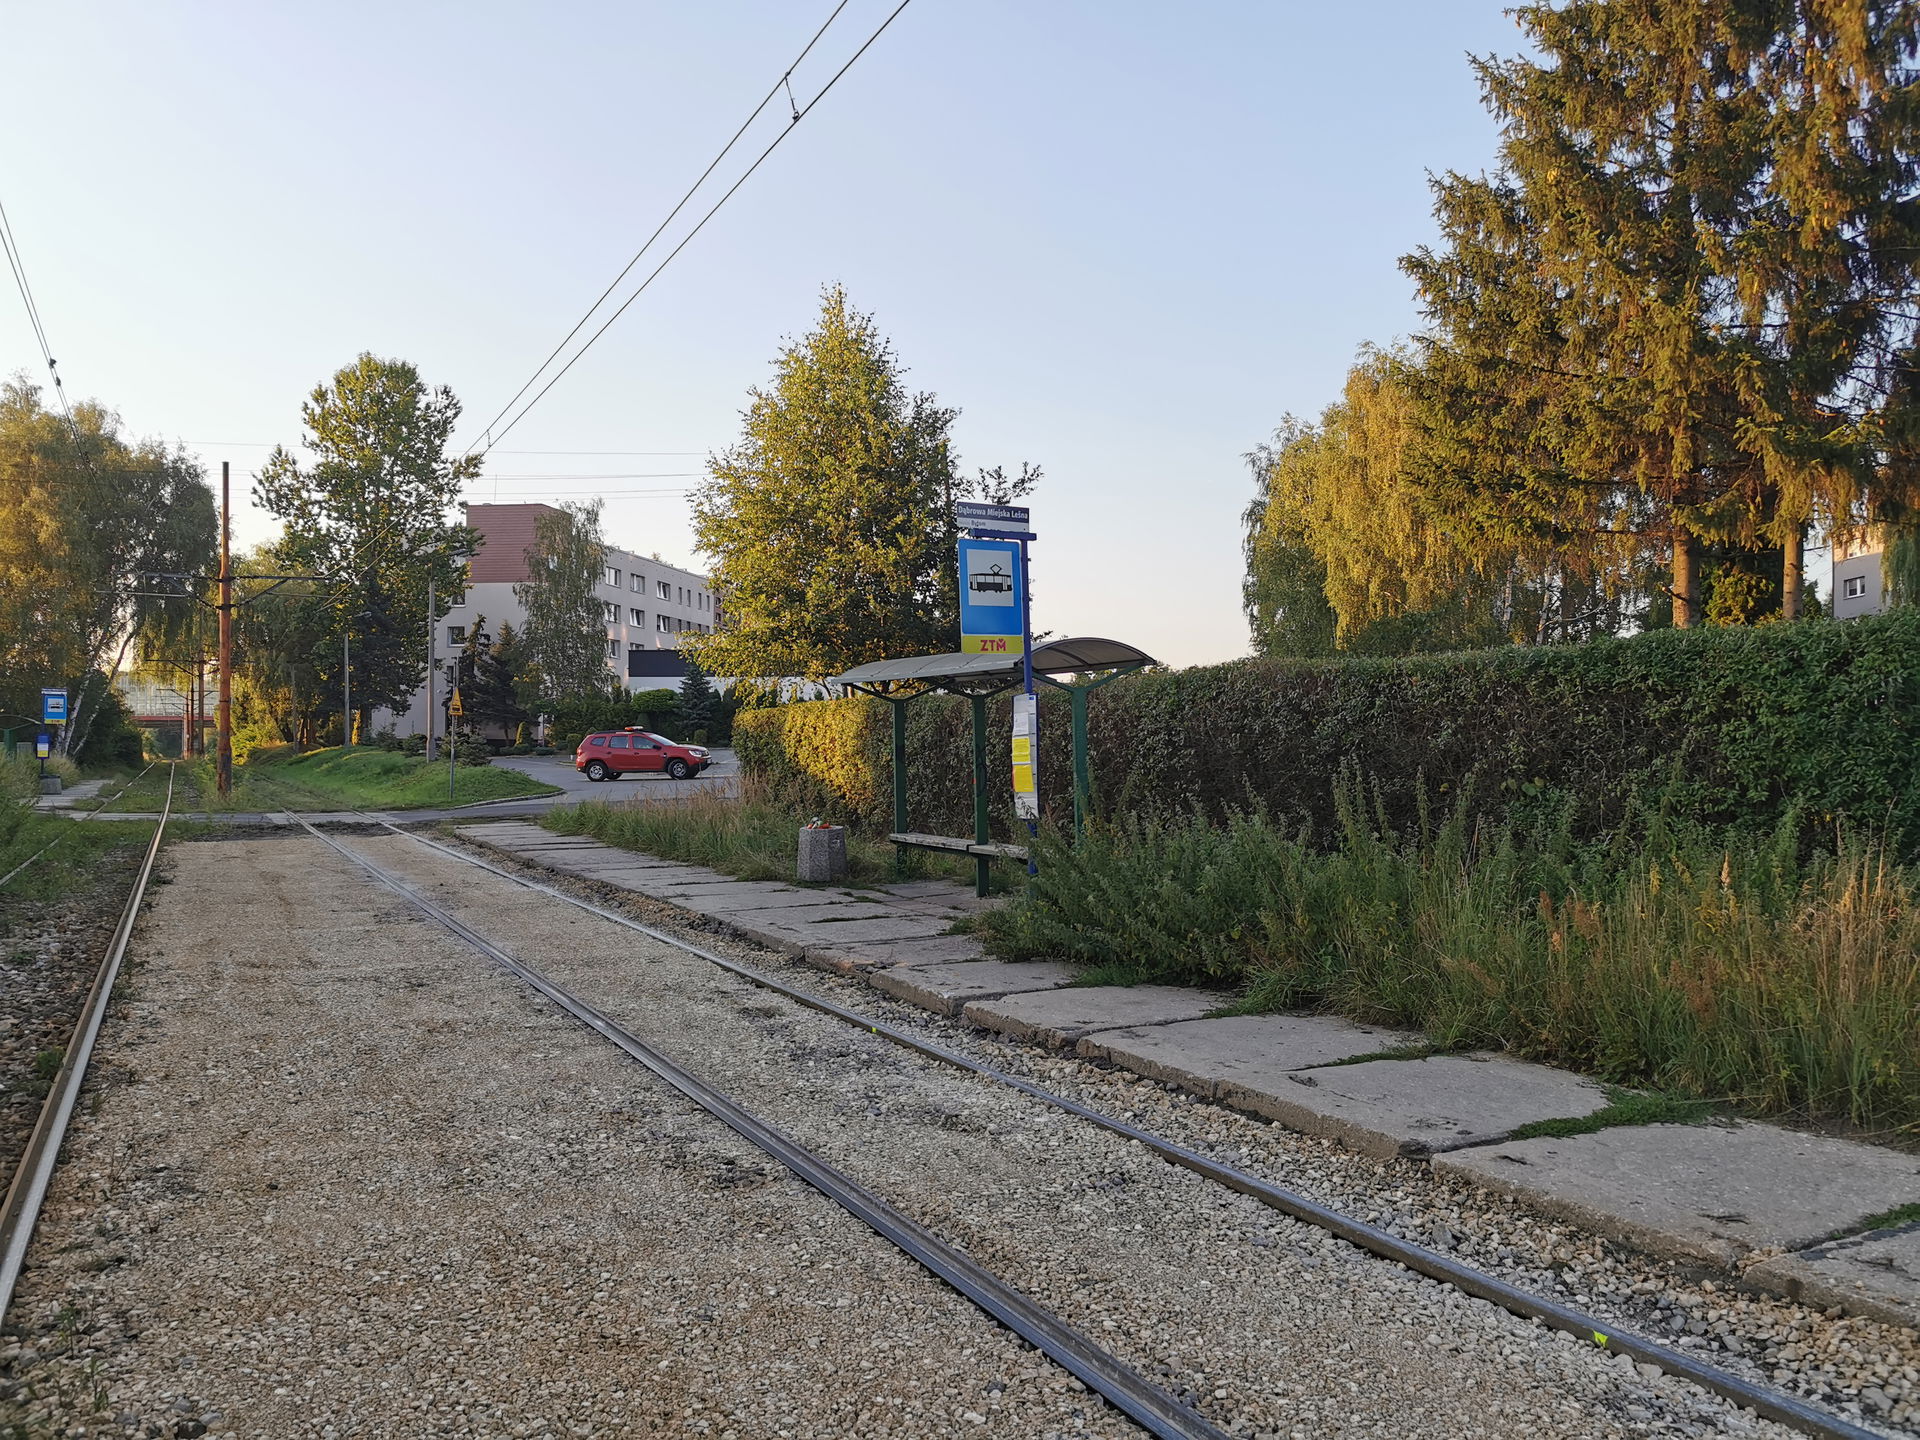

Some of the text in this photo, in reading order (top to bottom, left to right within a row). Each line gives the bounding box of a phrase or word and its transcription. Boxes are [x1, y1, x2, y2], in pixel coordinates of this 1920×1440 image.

[958, 506, 1028, 519] Dąbrowa Miejska Leśna
[980, 638, 1006, 652] ZTM
